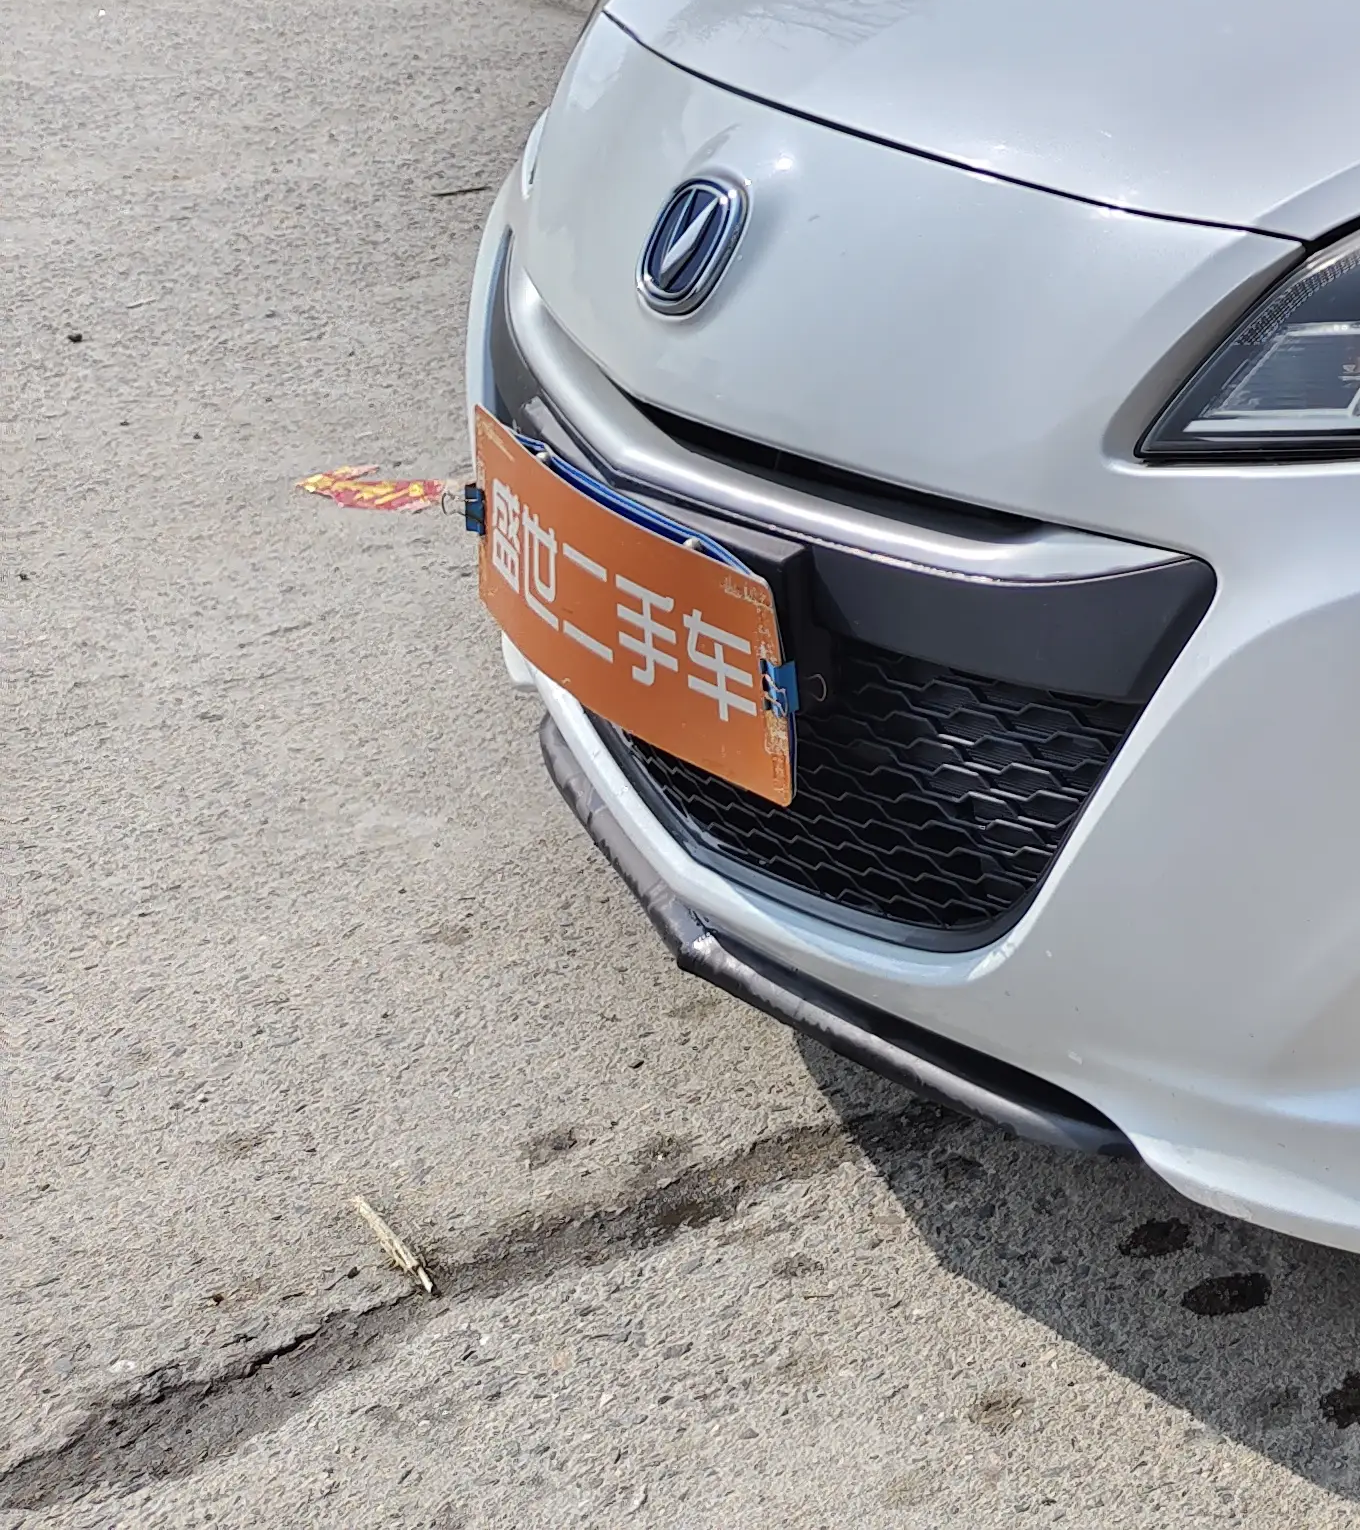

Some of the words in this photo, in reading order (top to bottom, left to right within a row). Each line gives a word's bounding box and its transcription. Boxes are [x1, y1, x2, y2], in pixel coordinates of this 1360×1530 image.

[492, 478, 757, 722] 盛世二手车
